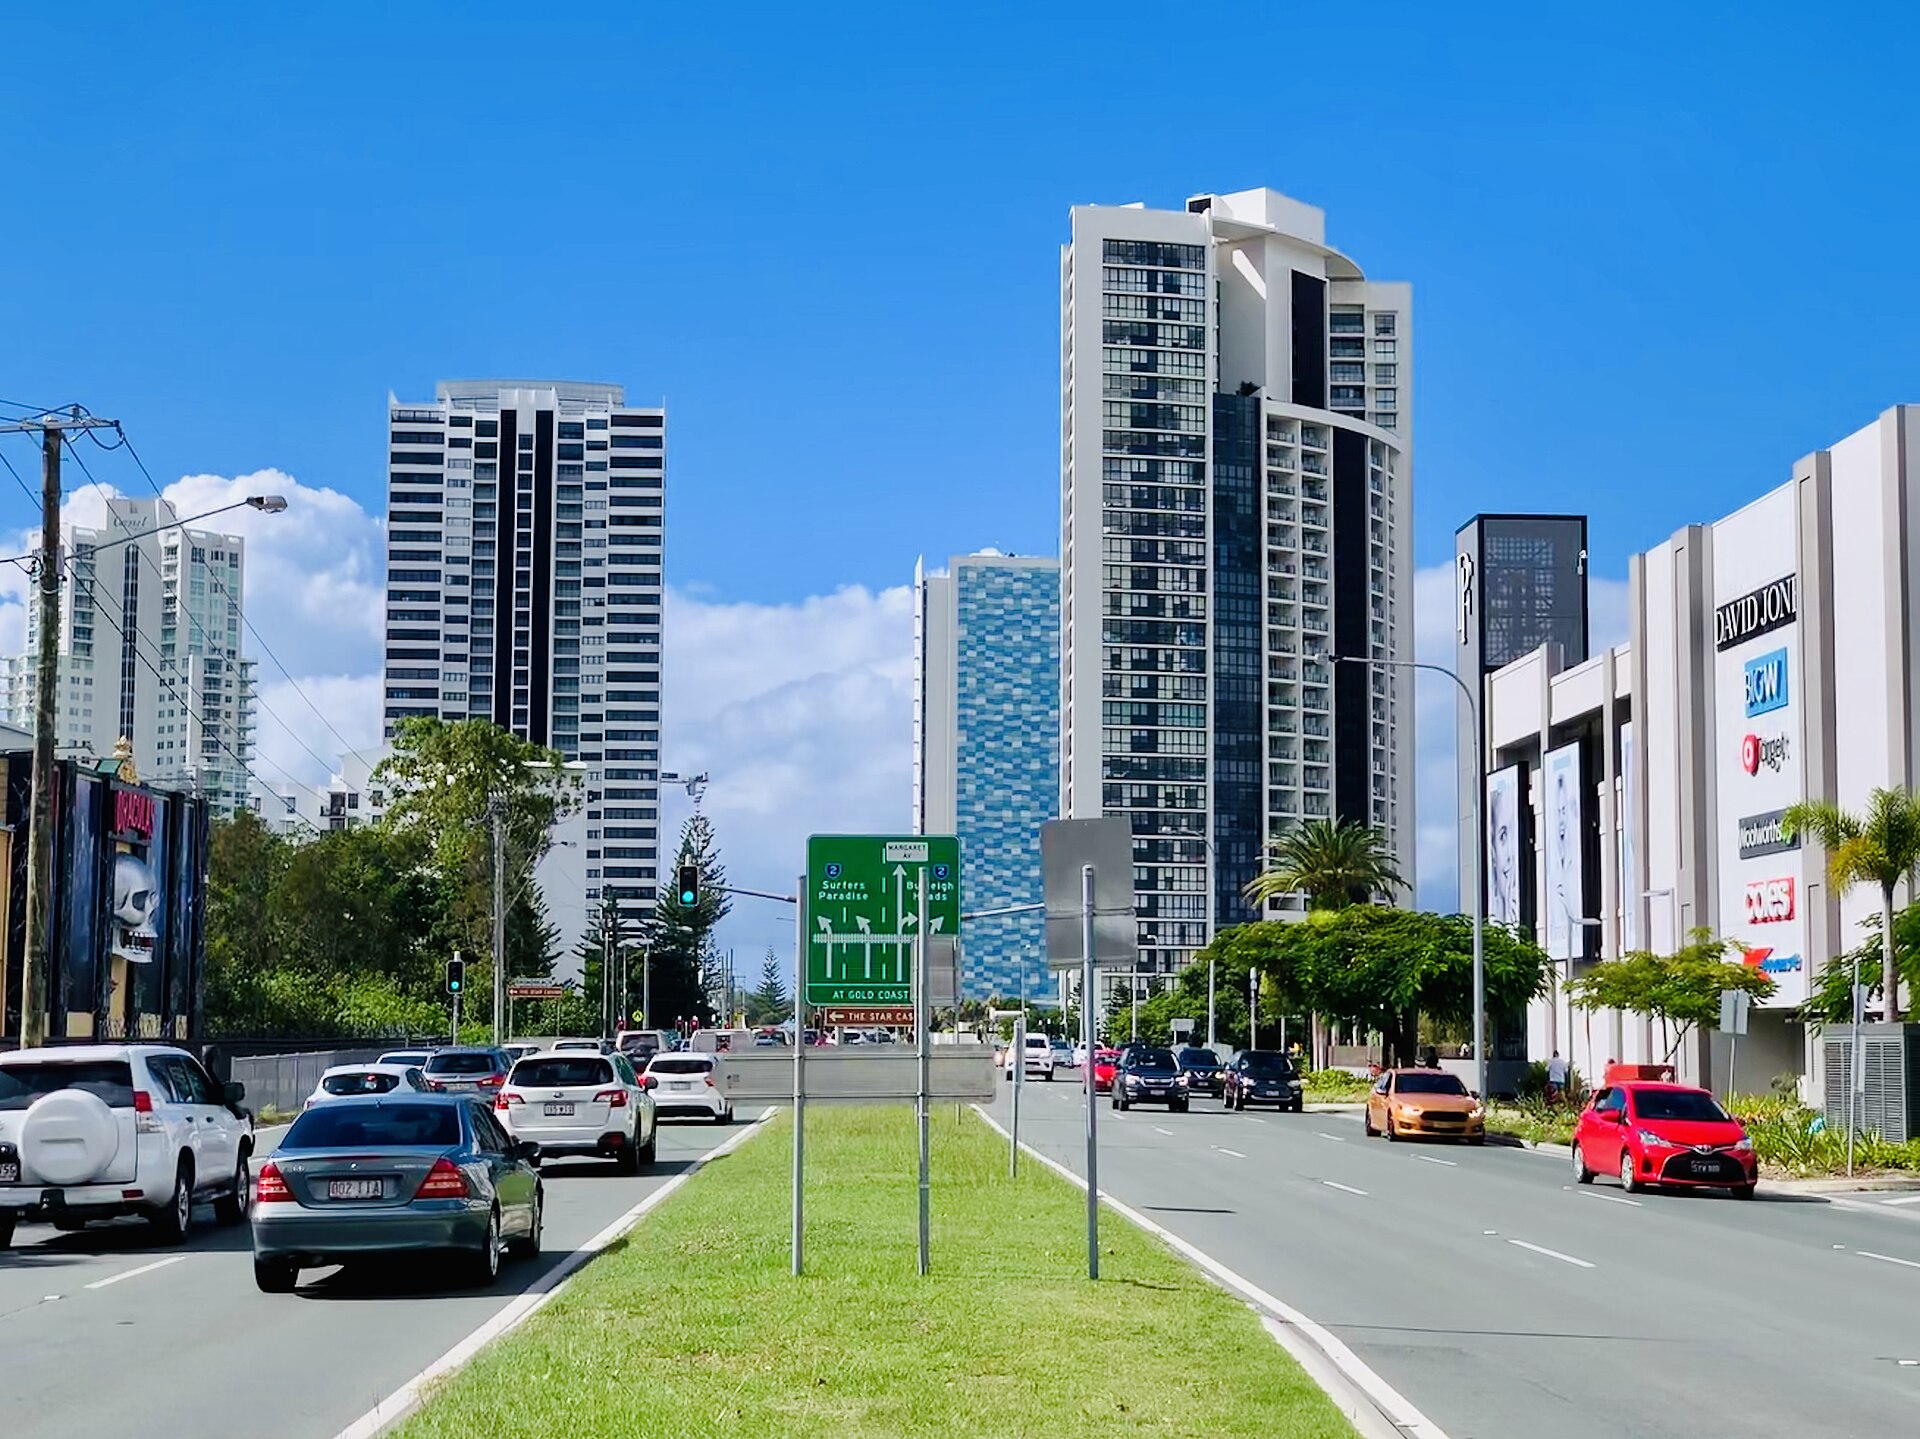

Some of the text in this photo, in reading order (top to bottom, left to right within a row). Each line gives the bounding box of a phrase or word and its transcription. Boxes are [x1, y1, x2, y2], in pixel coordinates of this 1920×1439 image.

[1714, 595, 1759, 645] DAVID
[830, 865, 838, 875] 2
[937, 867, 945, 876] 2
[822, 880, 866, 890] Surfers
[906, 881, 954, 892] Bueigh
[818, 890, 869, 901] Paradise
[912, 892, 948, 901] Hads
[833, 990, 909, 1000] AT GOLD COAST
[848, 1012, 914, 1021] THE STAR CAS
